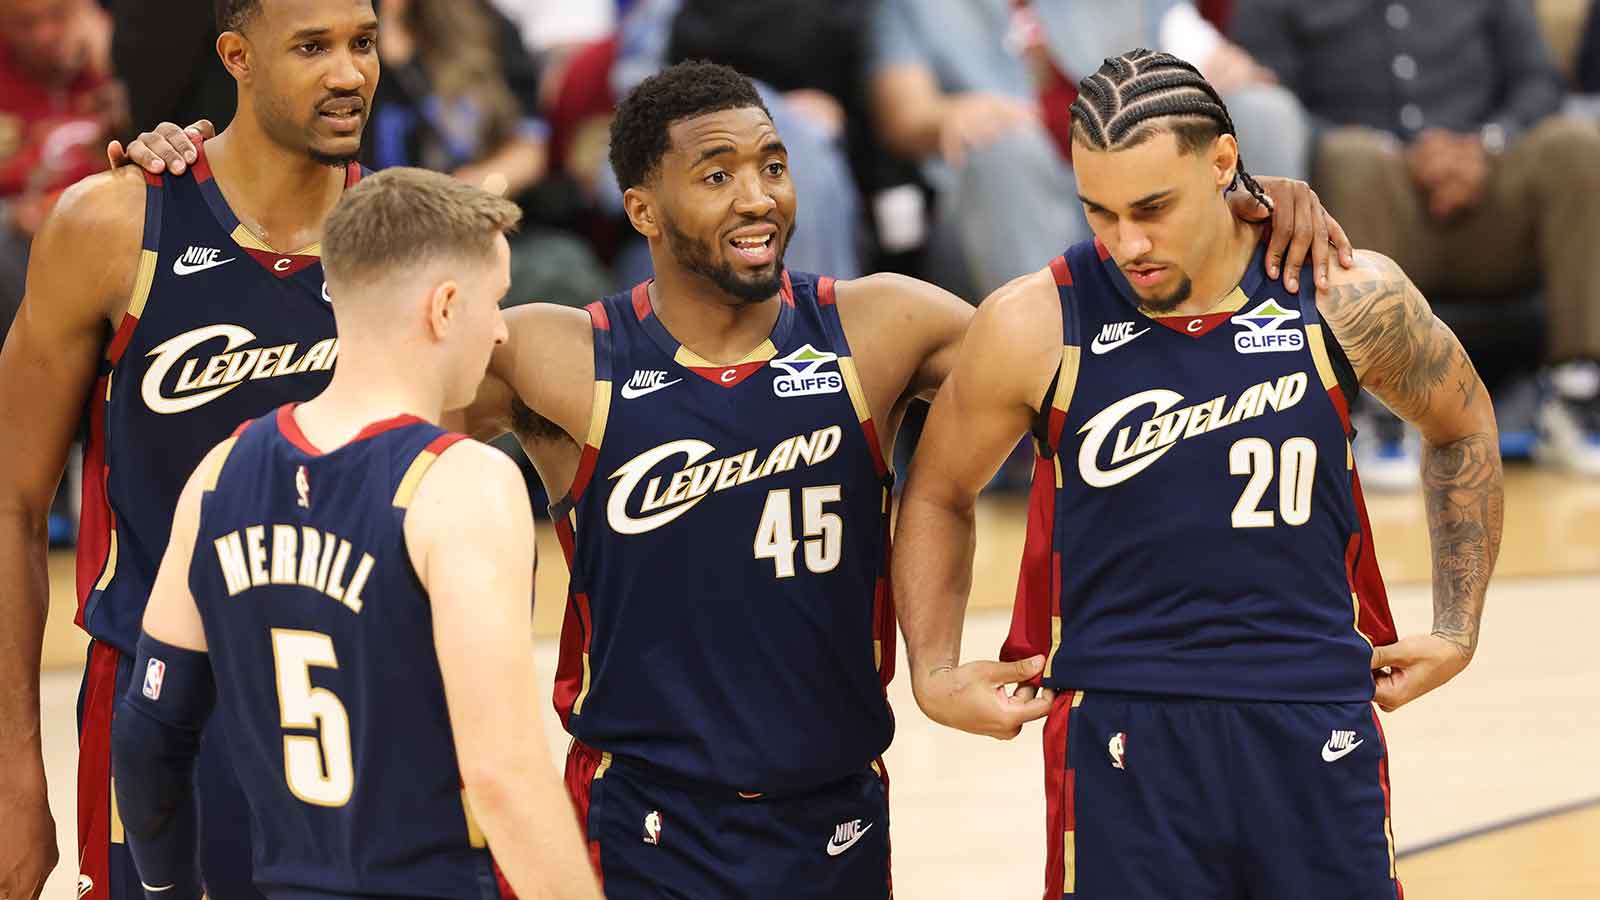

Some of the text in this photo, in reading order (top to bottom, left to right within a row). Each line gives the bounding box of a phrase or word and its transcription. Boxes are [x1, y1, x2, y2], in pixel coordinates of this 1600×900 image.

[182, 246, 221, 265] NIKE
[273, 258, 292, 271] C
[1099, 322, 1135, 341] NIKE
[1187, 319, 1203, 332] C
[1237, 333, 1301, 349] CLIFFS
[141, 323, 339, 415] CLEVELA
[630, 369, 668, 388] NIKE
[720, 369, 738, 383] C
[776, 375, 841, 393] CLIFFS
[1076, 371, 1308, 488] CLEVELAND
[606, 425, 842, 535] CLEVELAND
[1229, 437, 1318, 528] 20
[753, 484, 844, 578] 45
[214, 524, 375, 614] MERRILL
[270, 627, 355, 808] 5
[1329, 729, 1356, 748] NIKE
[834, 819, 862, 843] NIKE
